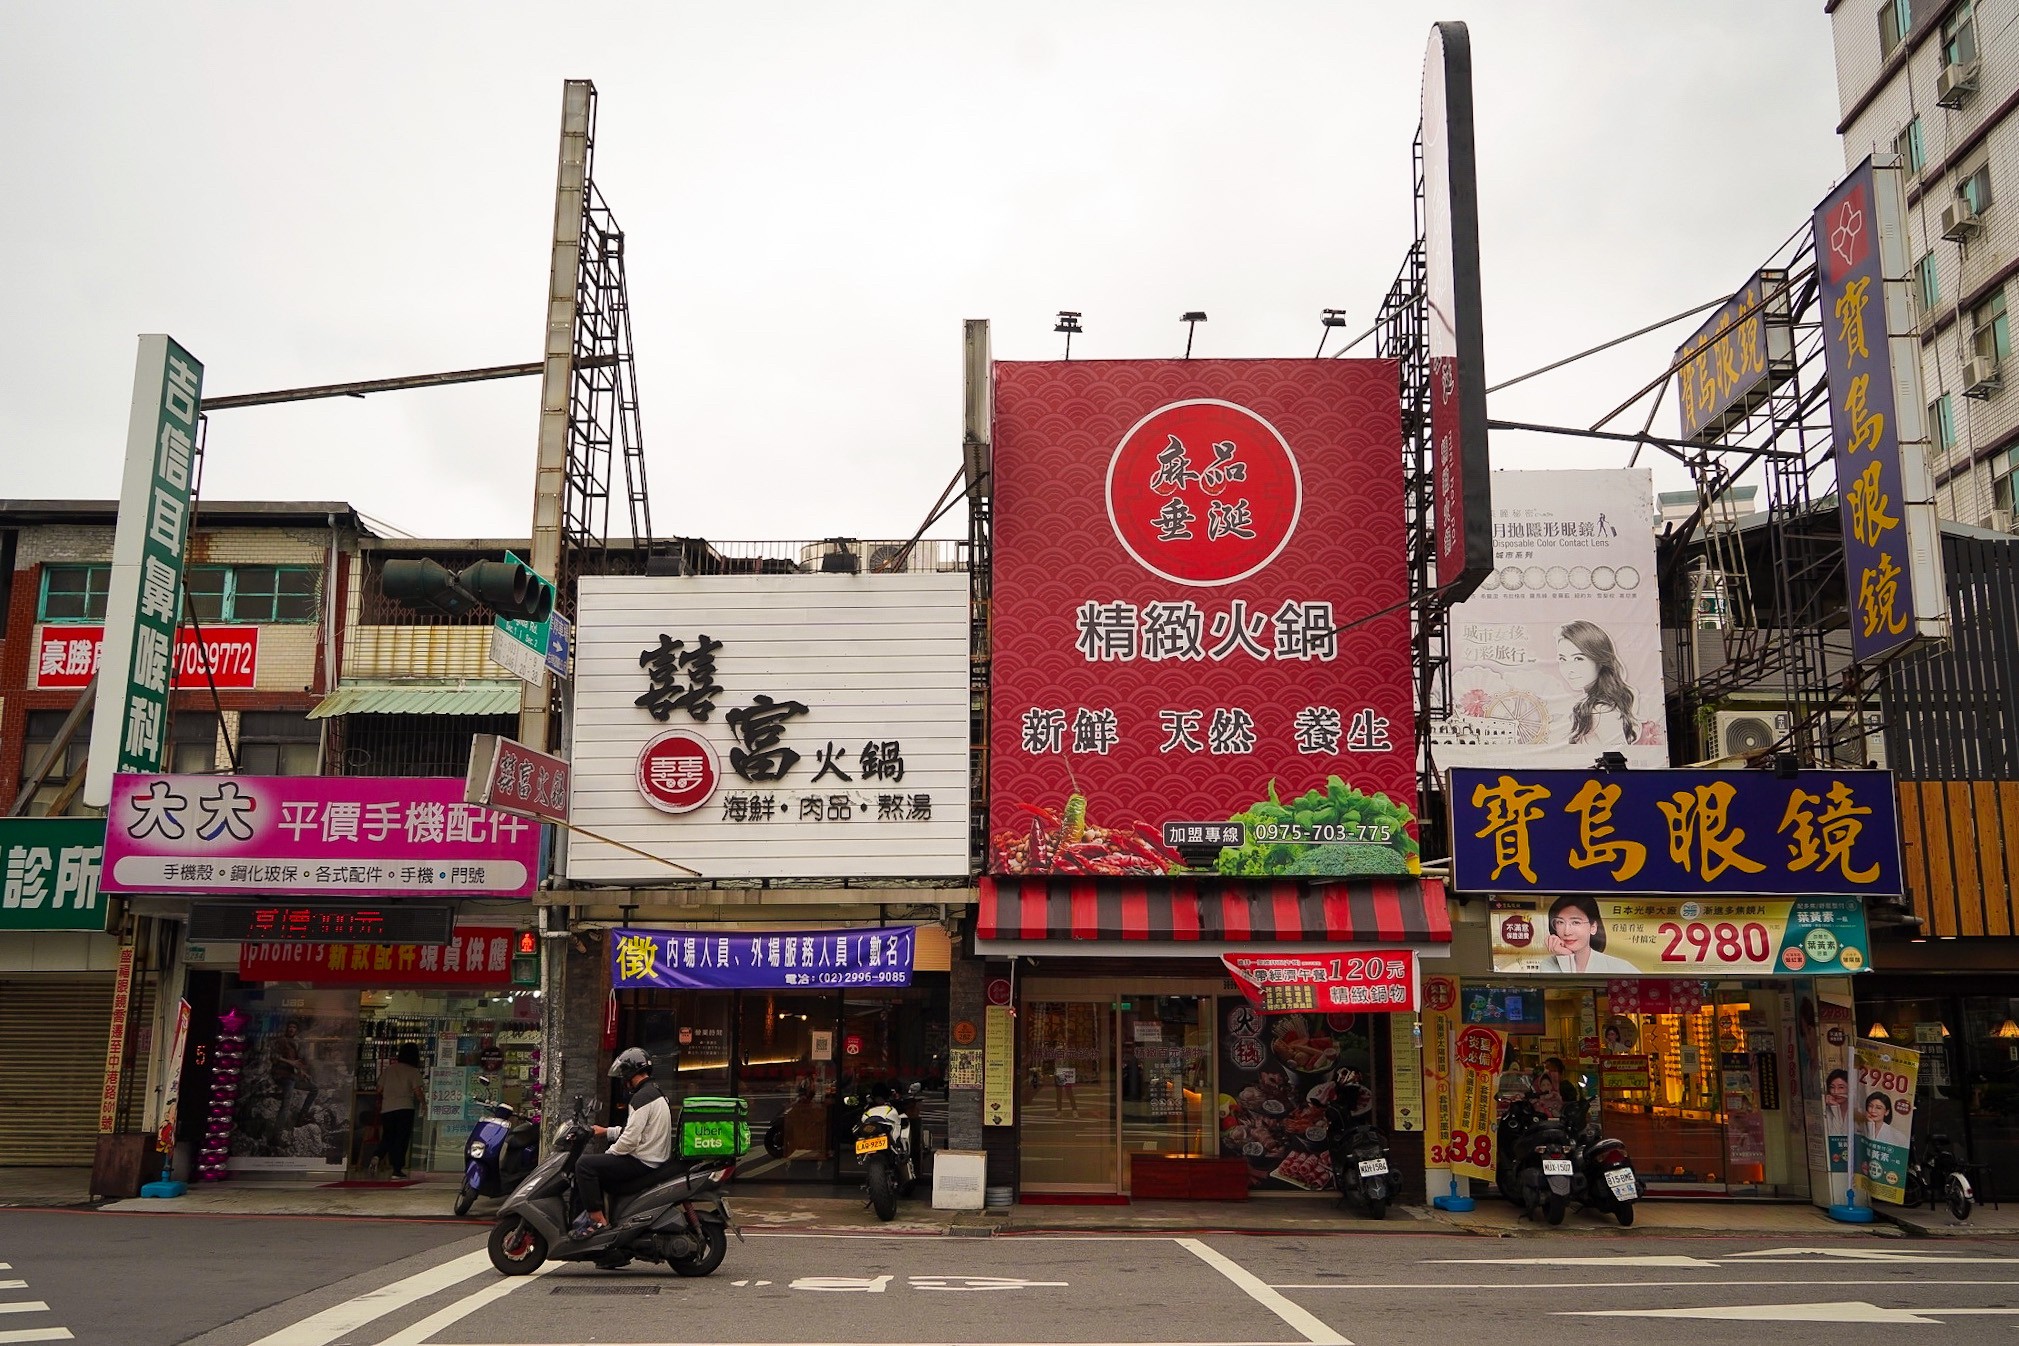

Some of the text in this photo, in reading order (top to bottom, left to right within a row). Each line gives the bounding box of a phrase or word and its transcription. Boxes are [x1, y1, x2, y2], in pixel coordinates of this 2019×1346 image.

[1679, 288, 1765, 433] 寶島眼鏡
[1149, 434, 1247, 491] 麻品
[1835, 275, 1908, 640] 寶島眼鏡
[1149, 498, 1256, 542] 垂涎
[126, 355, 198, 763] 吉信耳鼻喉科
[1492, 539, 1610, 548] Disposable Color Contact Lens
[1075, 600, 1338, 662] 精緻火鍋
[1021, 706, 1393, 756] 新鮮 天然 養生
[811, 740, 905, 784] 火鍋
[127, 781, 529, 844] 大大 平價手機配件
[722, 794, 932, 822] 海鮮 肉品 熬湯
[1168, 824, 1392, 844] 加盟專線 0975-703-775
[1472, 775, 1881, 885] 寶島眼鏡
[3, 845, 103, 910] 診所
[163, 864, 485, 884] 手機殼 鋼化玻保 各式配件 手機 門號
[1612, 905, 1678, 916] 日本光學大廠
[615, 935, 659, 981] 徵
[1657, 921, 1771, 963] 2980
[818, 971, 906, 984] (02)2996-9085
[1328, 957, 1406, 982] 120元
[1330, 985, 1407, 1004] 精緻鍋物
[1858, 1063, 1909, 1094] 2980
[694, 1137, 722, 1149] Eats
[695, 1126, 722, 1136] Uber
[1450, 1130, 1492, 1168] 3.8
